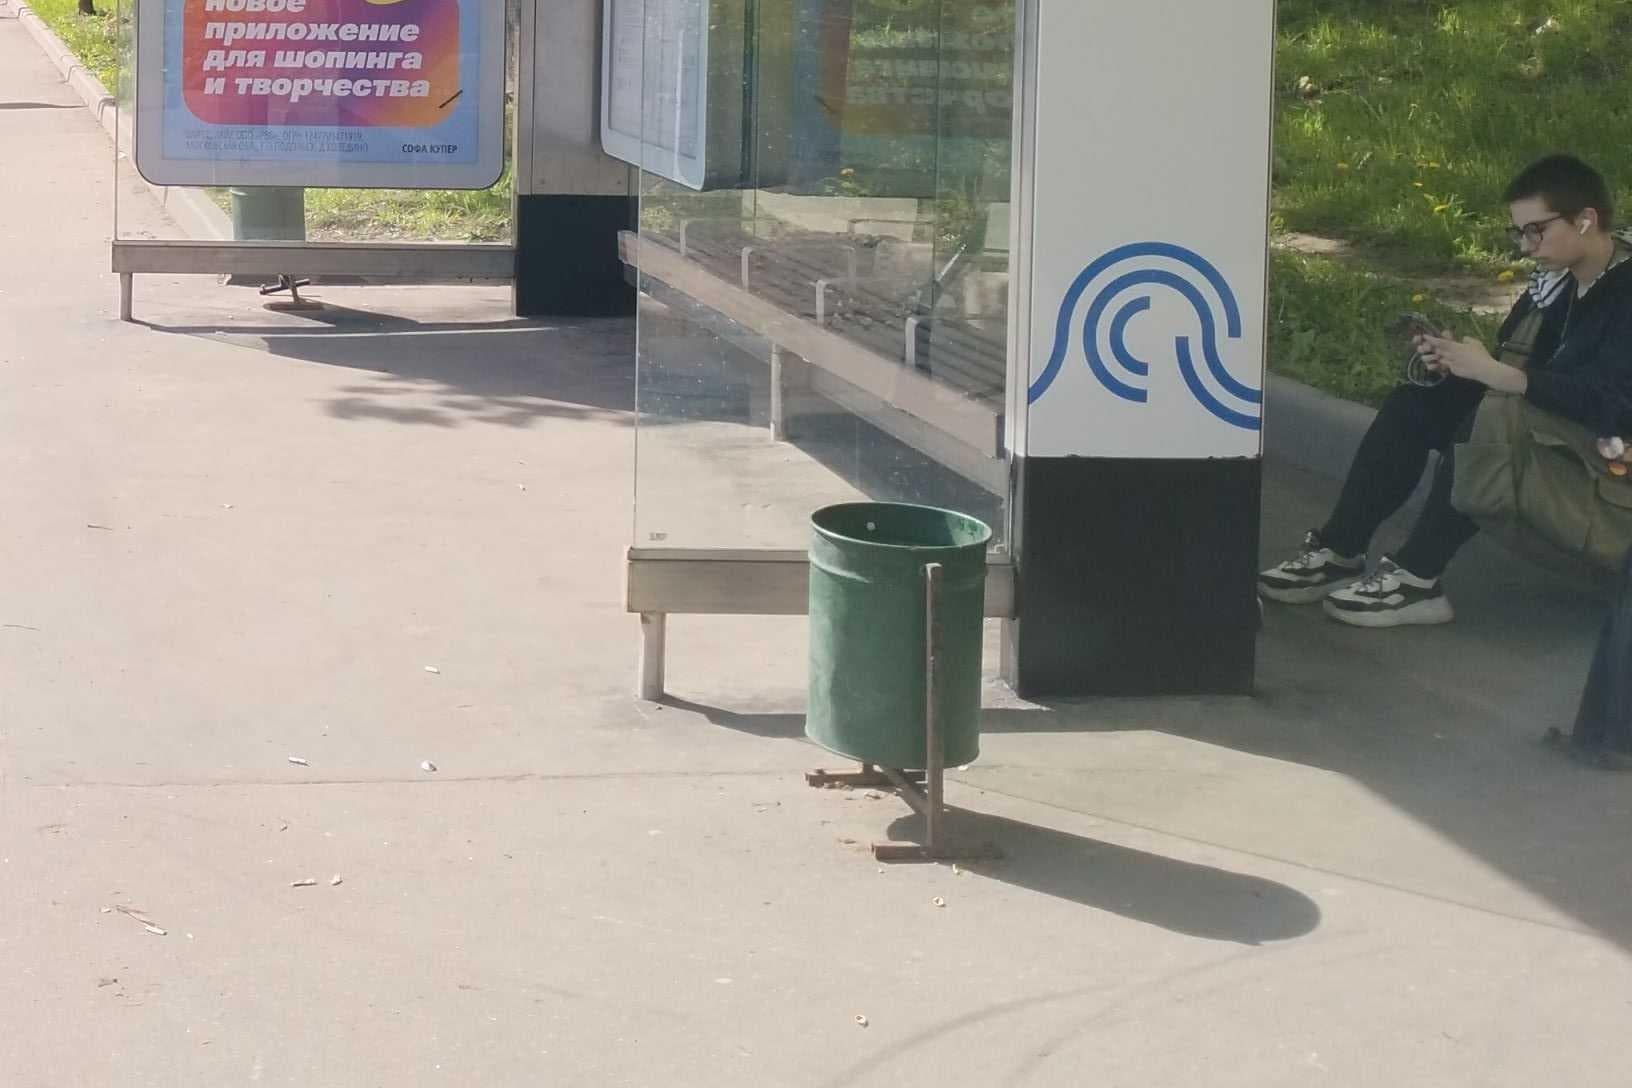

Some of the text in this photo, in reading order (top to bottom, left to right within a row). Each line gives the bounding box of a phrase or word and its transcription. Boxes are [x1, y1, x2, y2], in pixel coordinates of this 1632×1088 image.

[203, 21, 420, 44] приложение
[202, 49, 423, 72] для шопинга
[203, 76, 430, 103] и творчества
[401, 143, 429, 154] СОФА
